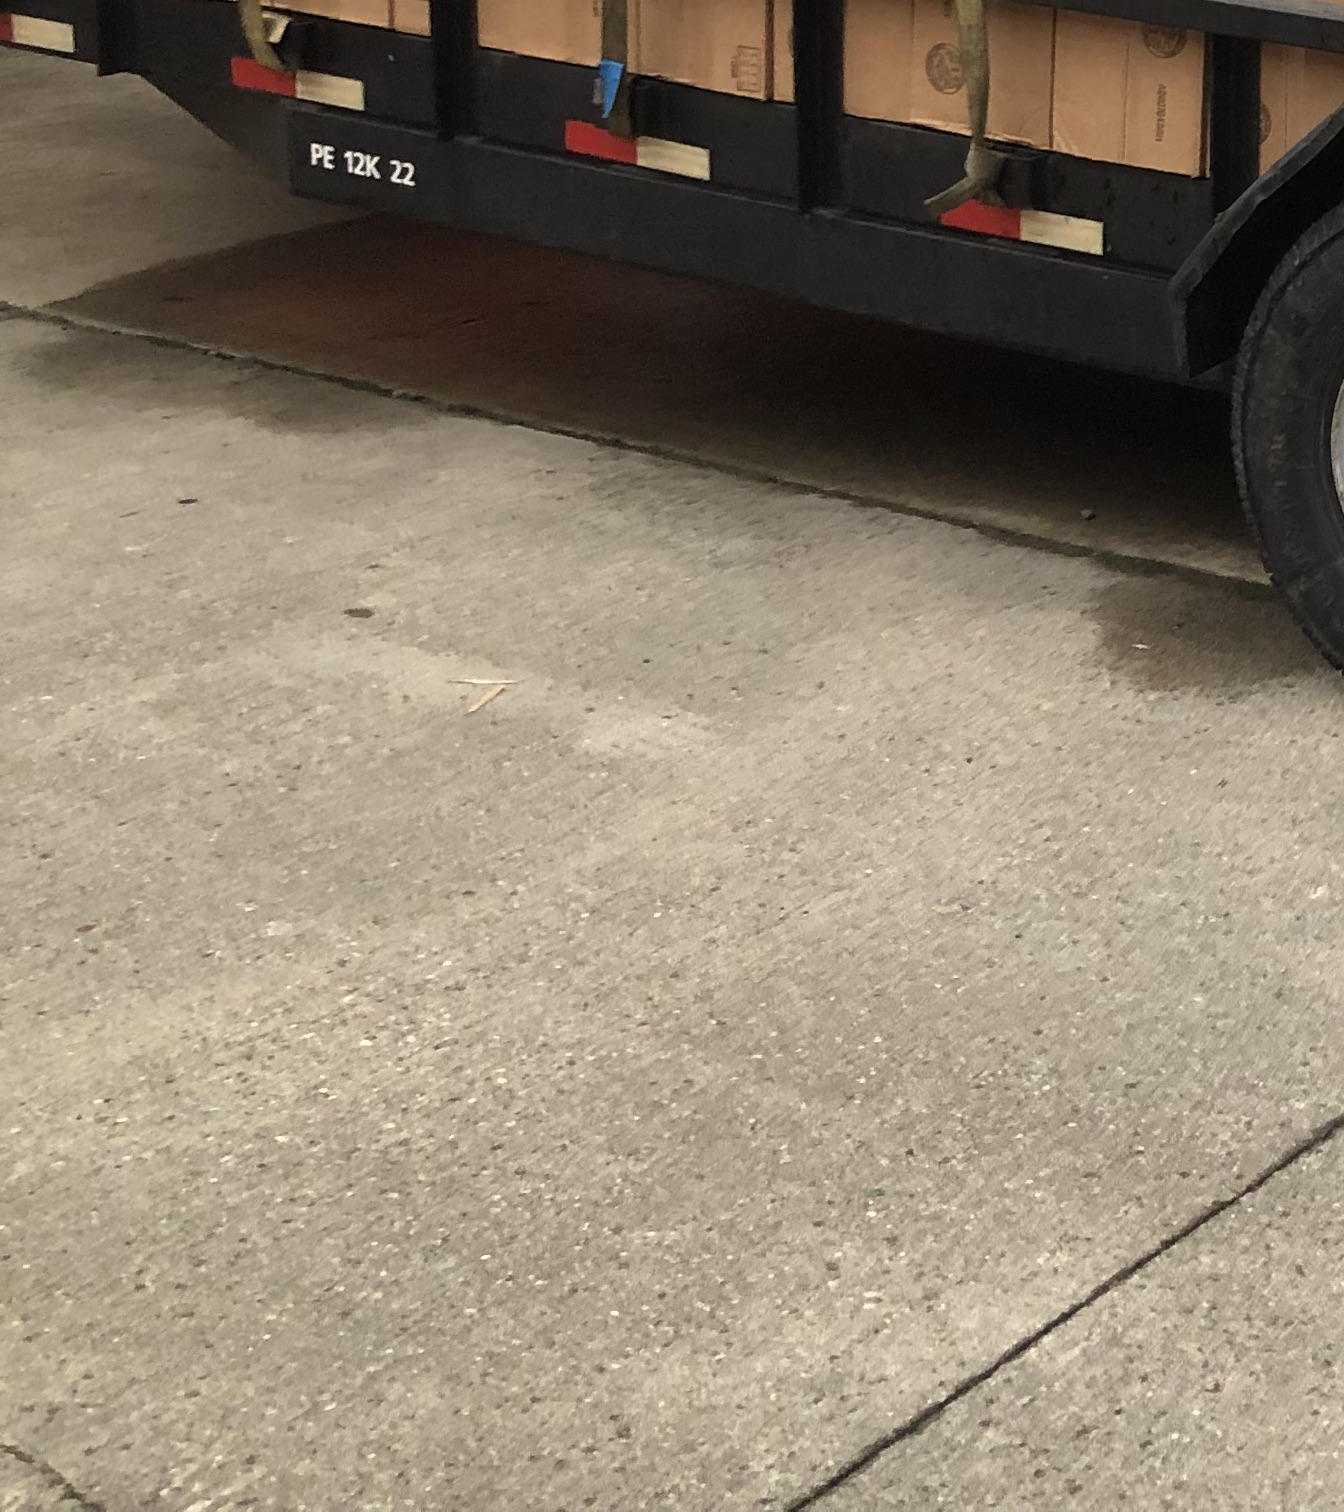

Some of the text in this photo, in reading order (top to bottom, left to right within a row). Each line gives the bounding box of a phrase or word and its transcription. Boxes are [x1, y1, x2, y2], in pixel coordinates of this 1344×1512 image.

[310, 142, 416, 187] PE 12K 22
